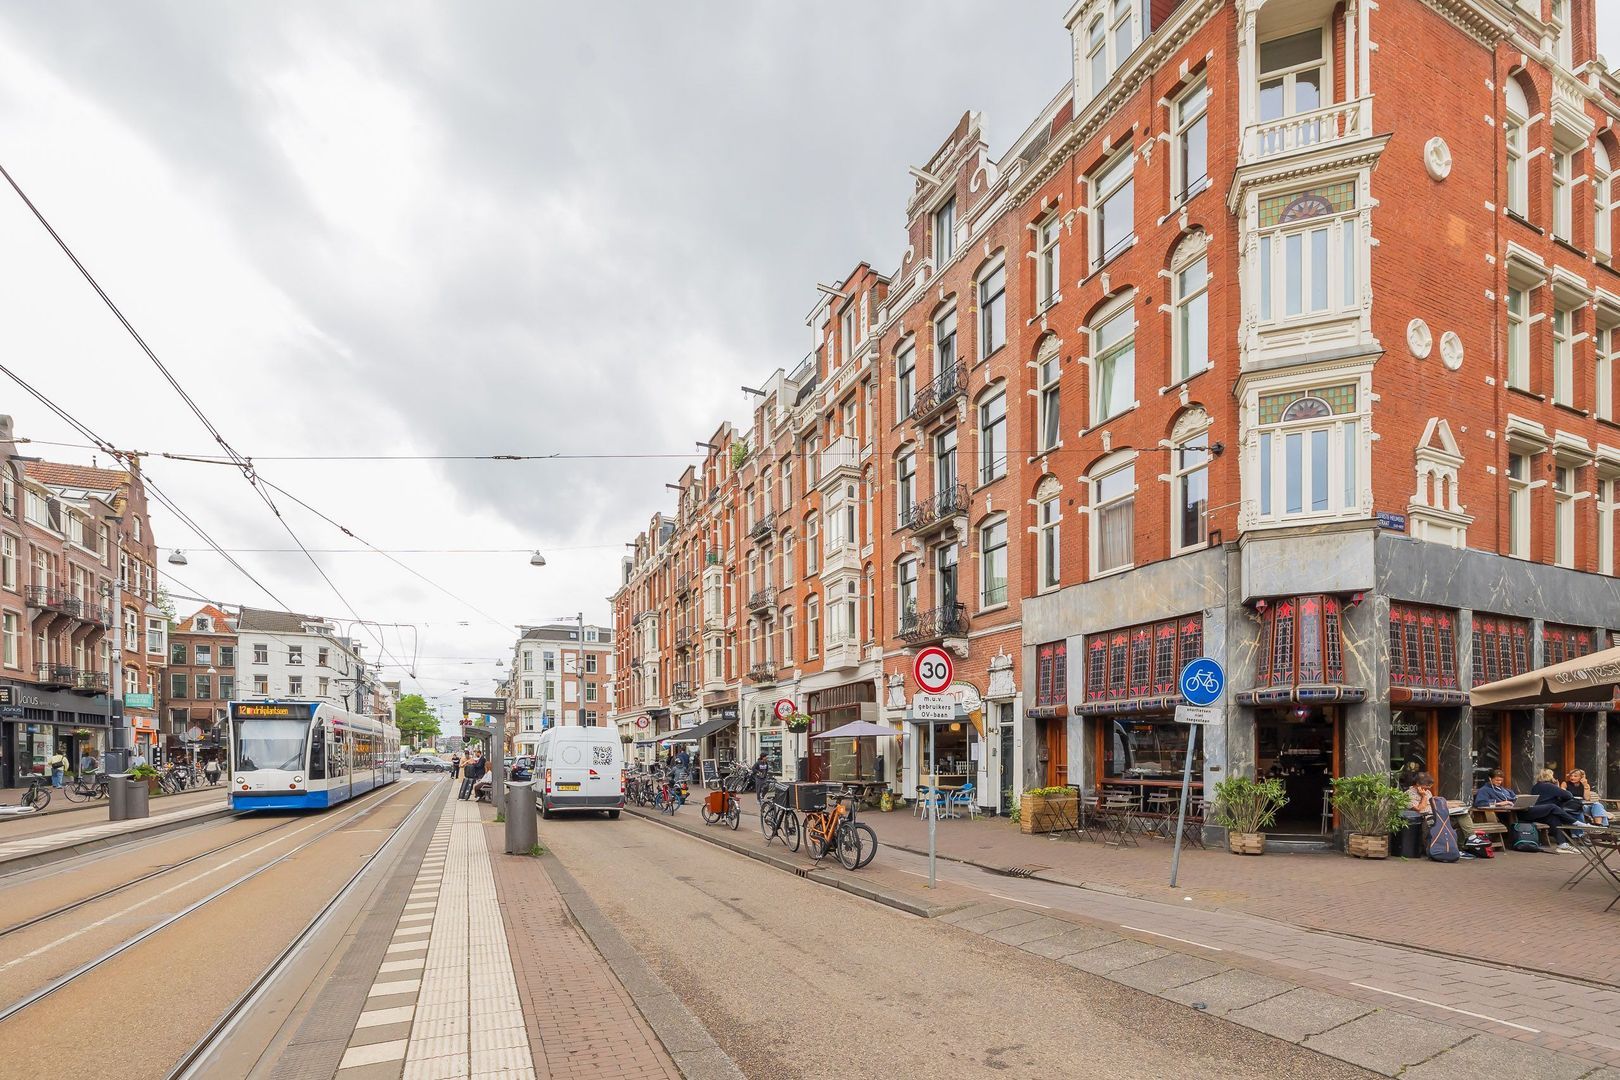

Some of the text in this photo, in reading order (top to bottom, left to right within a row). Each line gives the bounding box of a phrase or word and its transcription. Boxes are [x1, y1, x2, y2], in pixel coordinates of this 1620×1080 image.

[922, 662, 946, 679] 30
[1555, 672, 1572, 684] de
[20, 690, 38, 705] Janus
[240, 705, 246, 714] 12
